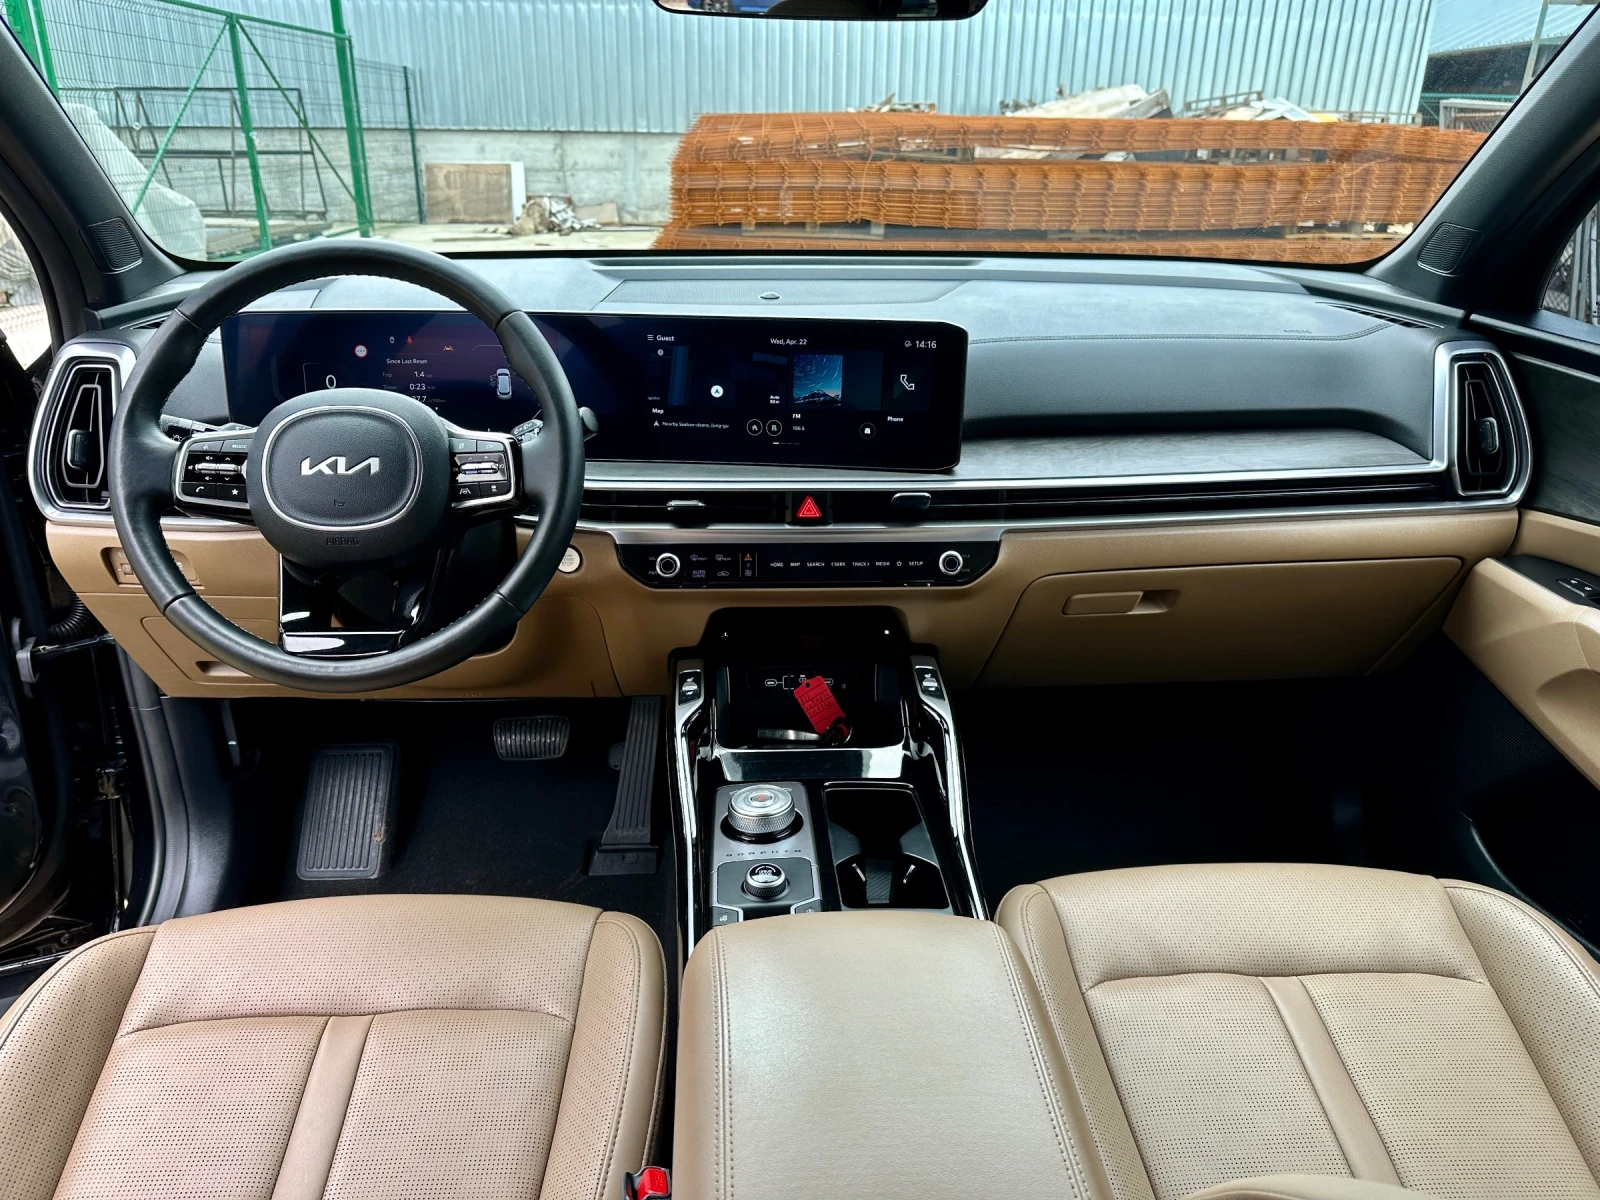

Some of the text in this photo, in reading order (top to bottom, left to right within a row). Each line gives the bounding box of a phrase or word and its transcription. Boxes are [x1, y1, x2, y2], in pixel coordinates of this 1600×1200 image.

[656, 334, 675, 342] Guest
[770, 338, 785, 346] Wed,
[785, 338, 798, 346] Apr.
[915, 340, 937, 349] 14:16
[325, 374, 337, 389] 0
[301, 456, 380, 476] KIA
